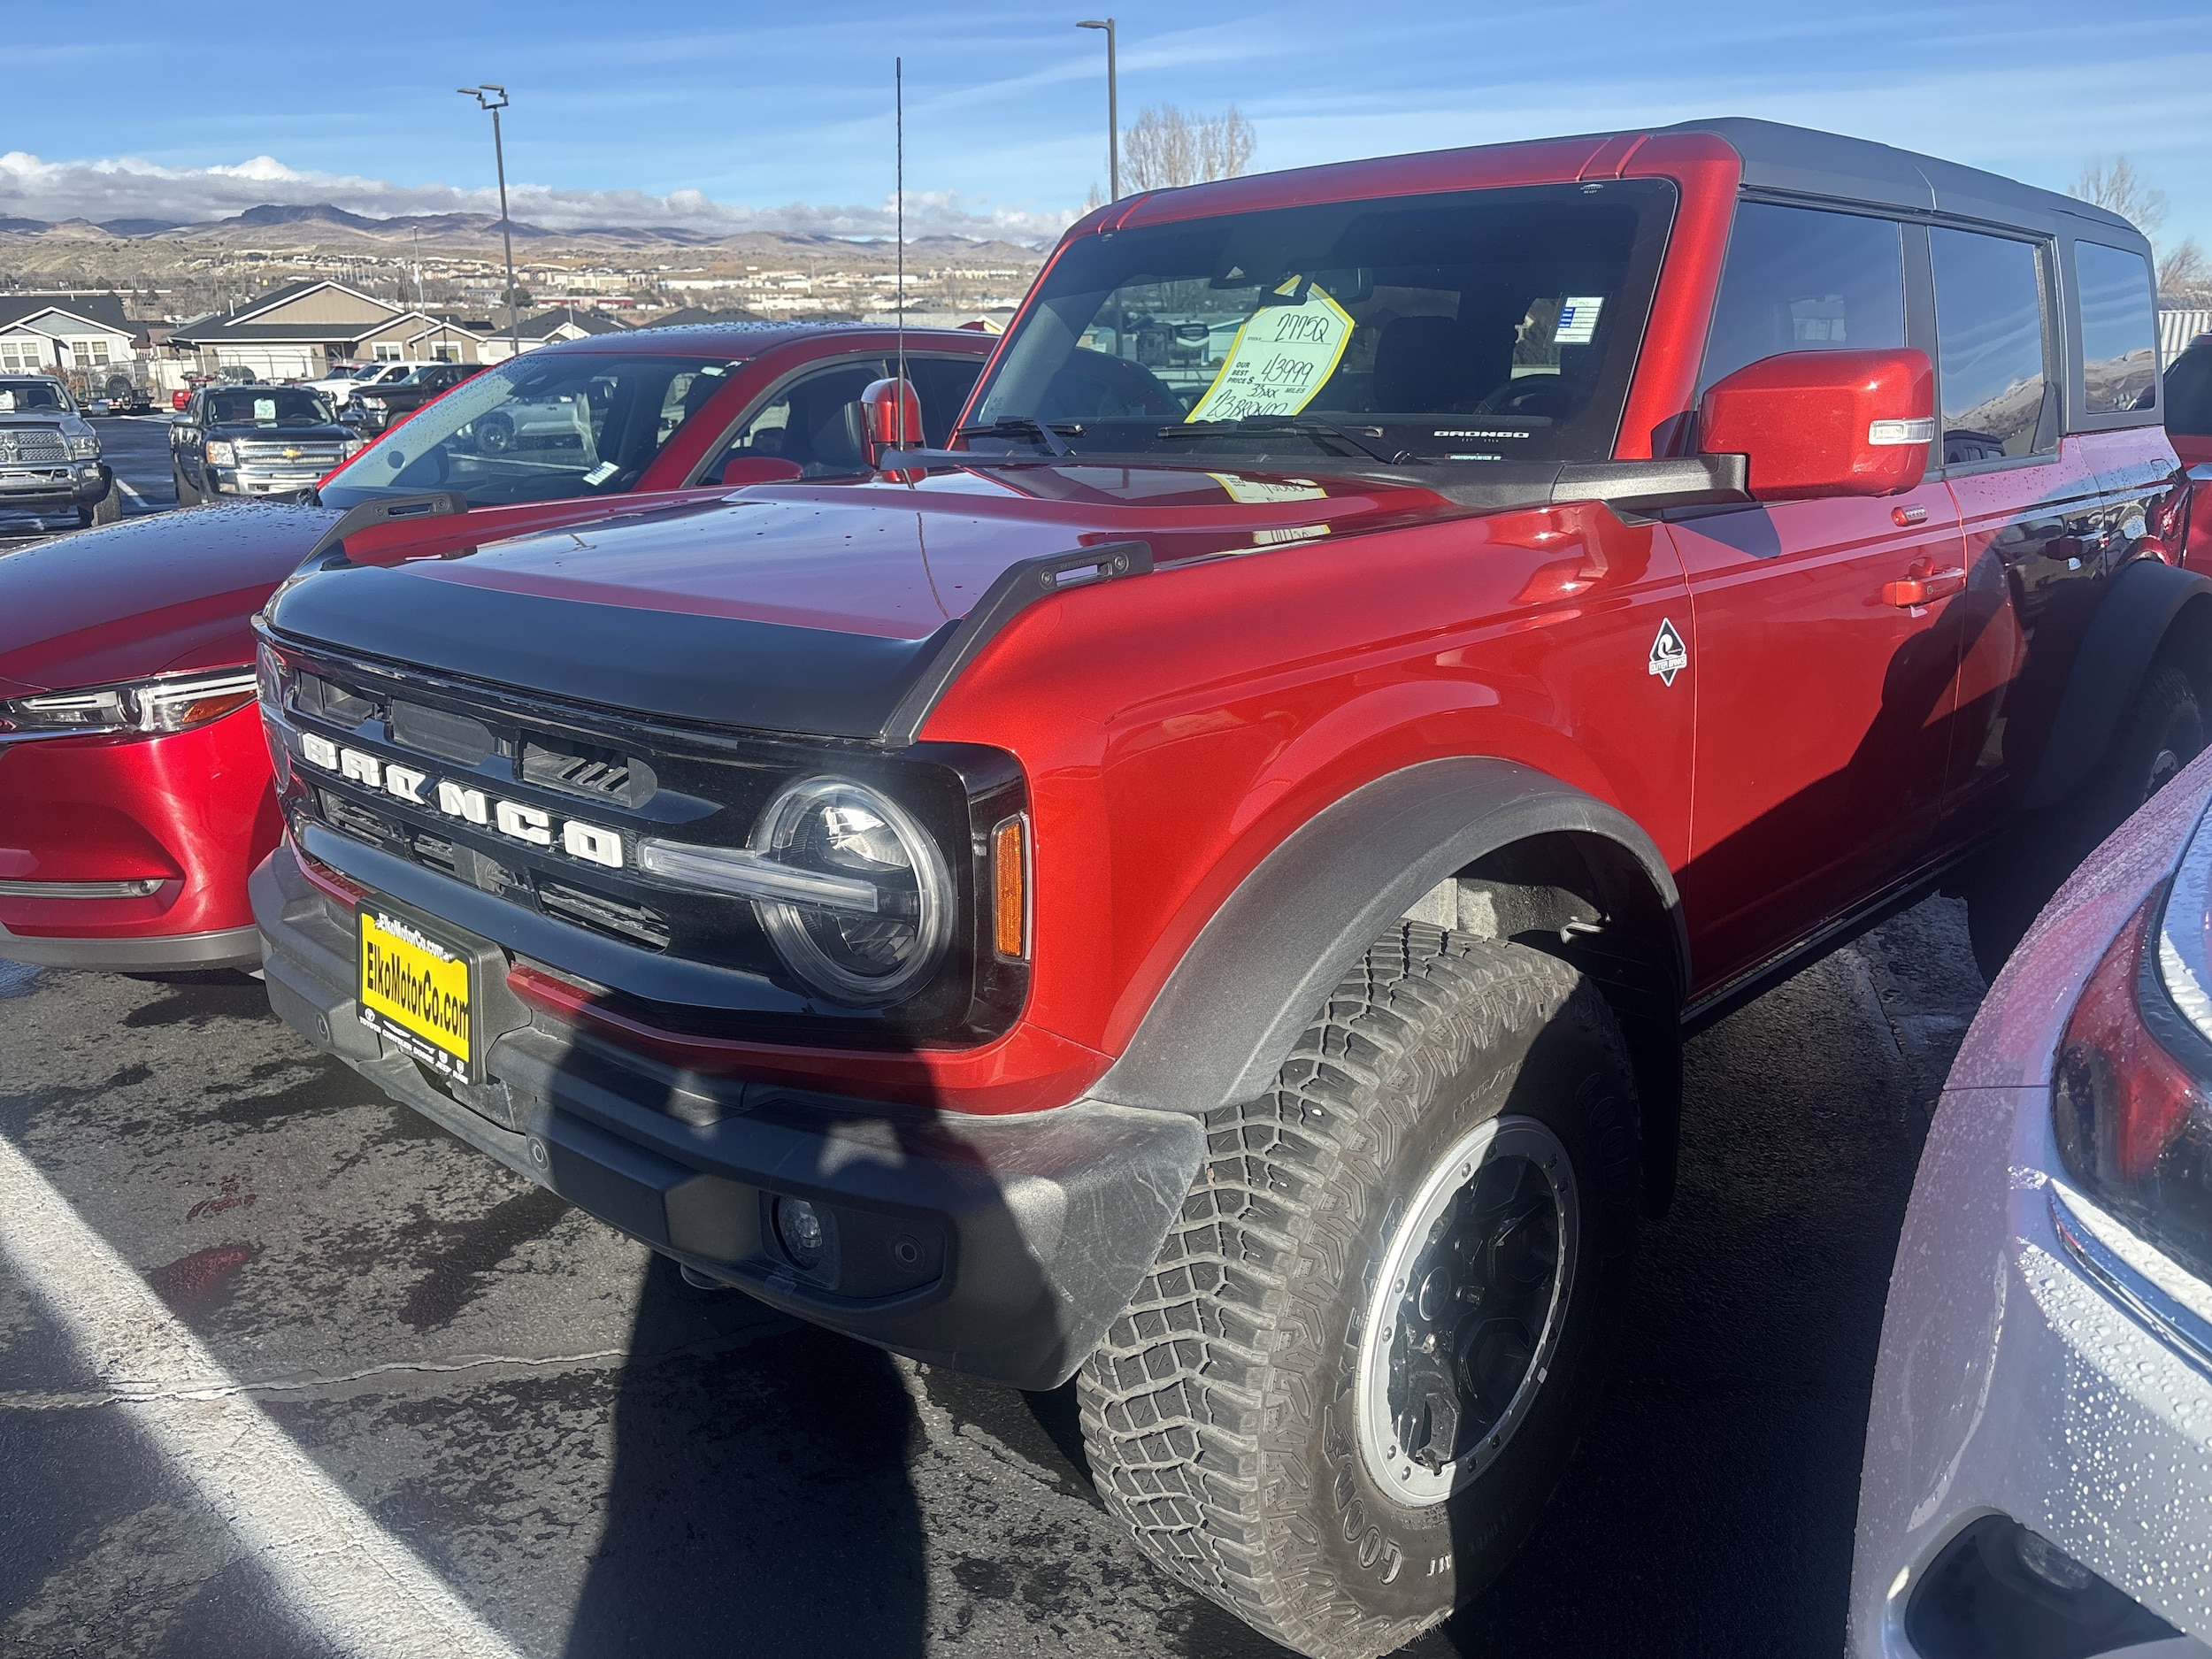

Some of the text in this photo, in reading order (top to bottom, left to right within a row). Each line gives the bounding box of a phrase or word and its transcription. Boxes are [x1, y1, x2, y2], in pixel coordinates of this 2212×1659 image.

[1261, 353, 1314, 385] 43999
[303, 733, 623, 868] BRONCO
[367, 941, 469, 1041] ElkoMotorCo.com
[359, 1016, 381, 1033] TOYOTA
[413, 1047, 434, 1064] DODGE
[435, 1061, 452, 1073] JEEP
